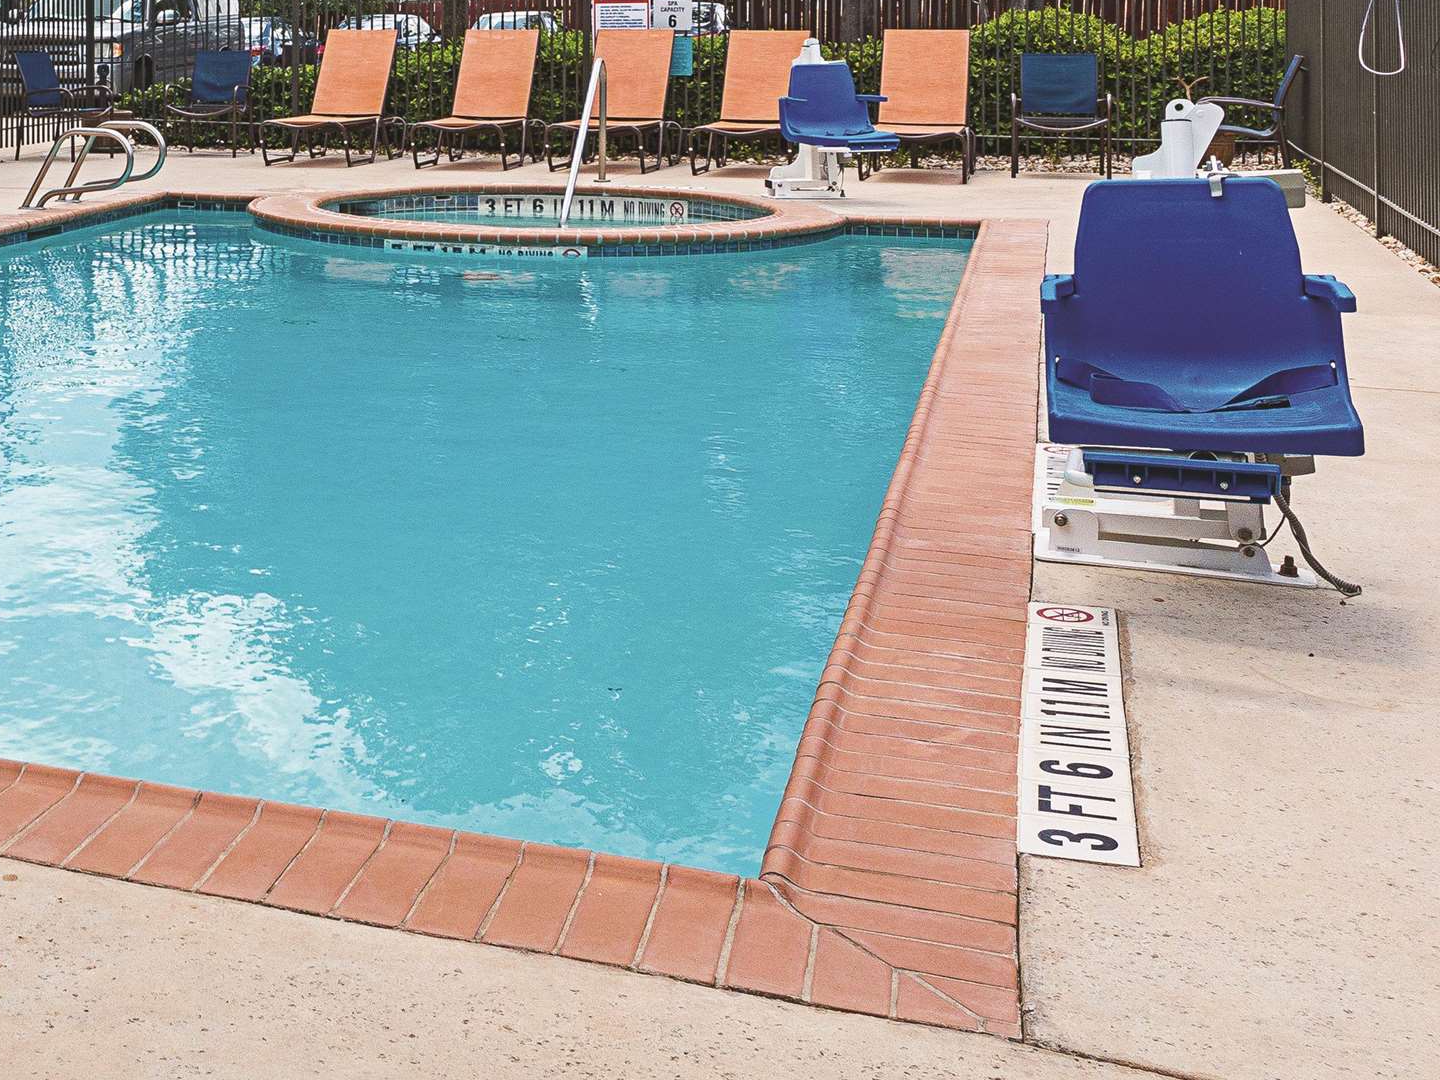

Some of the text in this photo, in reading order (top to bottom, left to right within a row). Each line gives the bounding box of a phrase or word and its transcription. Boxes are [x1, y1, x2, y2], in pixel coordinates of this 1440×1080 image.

[668, 14, 677, 28] 6
[485, 198, 496, 214] 3
[504, 198, 524, 214] FT
[533, 198, 545, 214] 6
[600, 200, 615, 217] M
[623, 201, 635, 219] NO
[639, 202, 665, 219] DIVING
[1042, 627, 1105, 657] DIVING
[1041, 657, 1106, 672] NO
[1042, 677, 1108, 697] M
[1040, 724, 1112, 751] IN
[1039, 759, 1113, 780] 6
[1038, 784, 1117, 821] FT
[1037, 828, 1119, 851] 3
